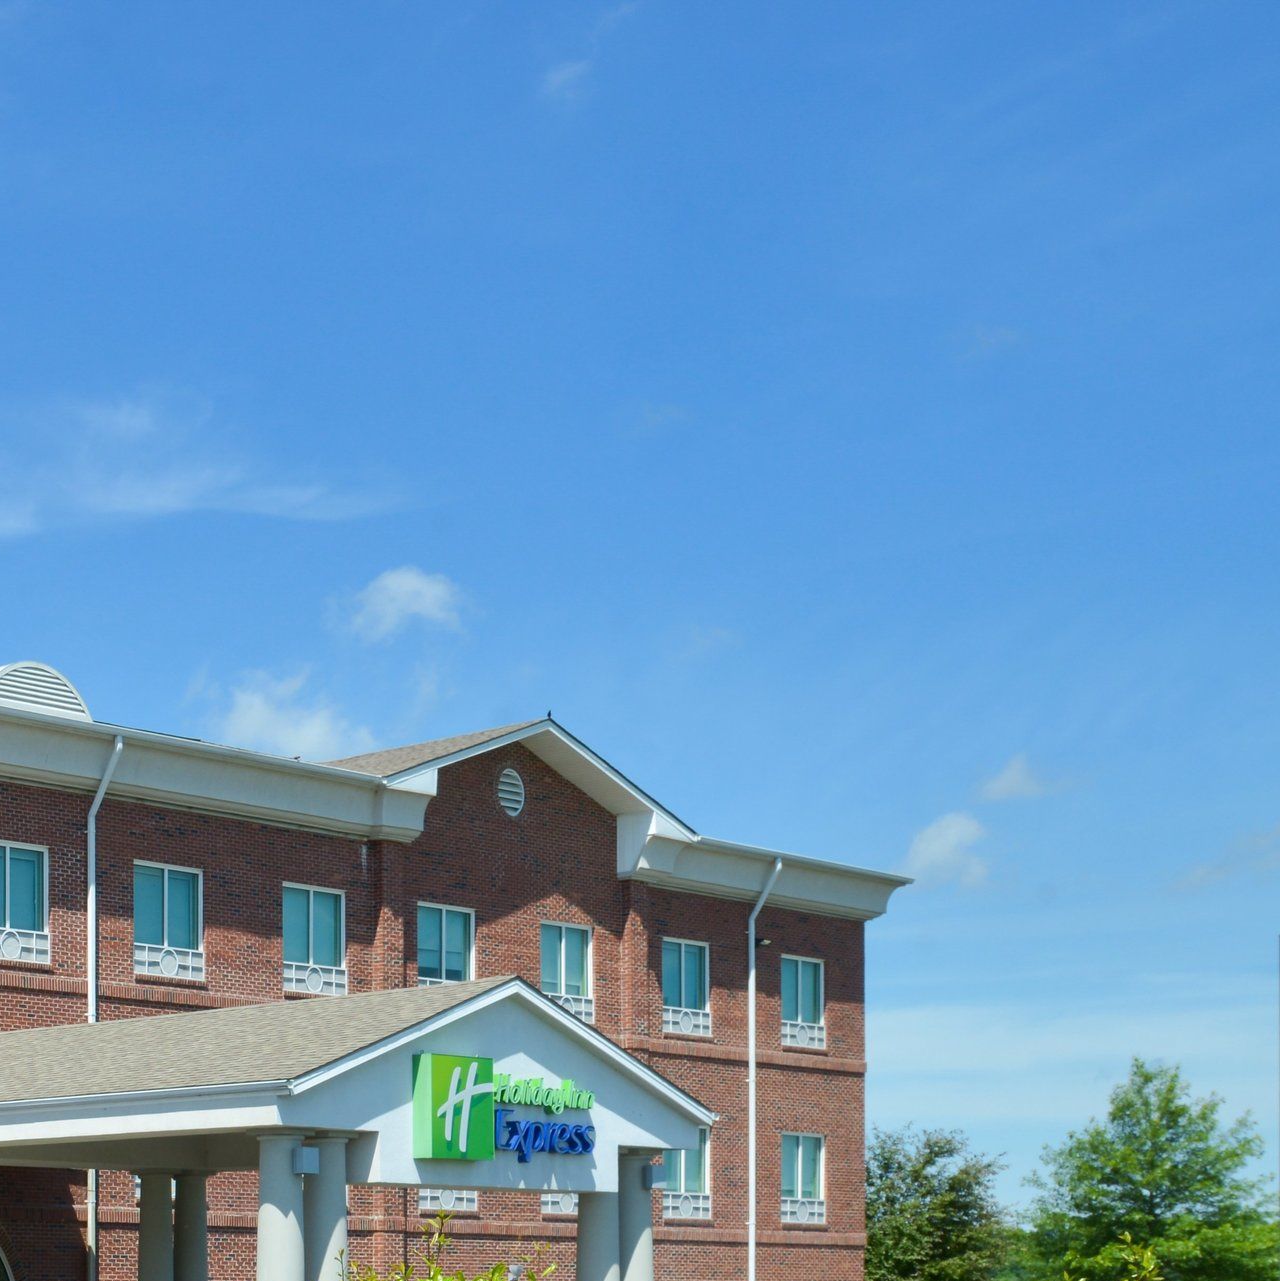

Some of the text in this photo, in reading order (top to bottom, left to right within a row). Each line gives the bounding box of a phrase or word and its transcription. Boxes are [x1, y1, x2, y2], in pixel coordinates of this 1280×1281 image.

[437, 1061, 494, 1153] H
[493, 1073, 594, 1115] Holiday Inn
[494, 1107, 595, 1163] Express
